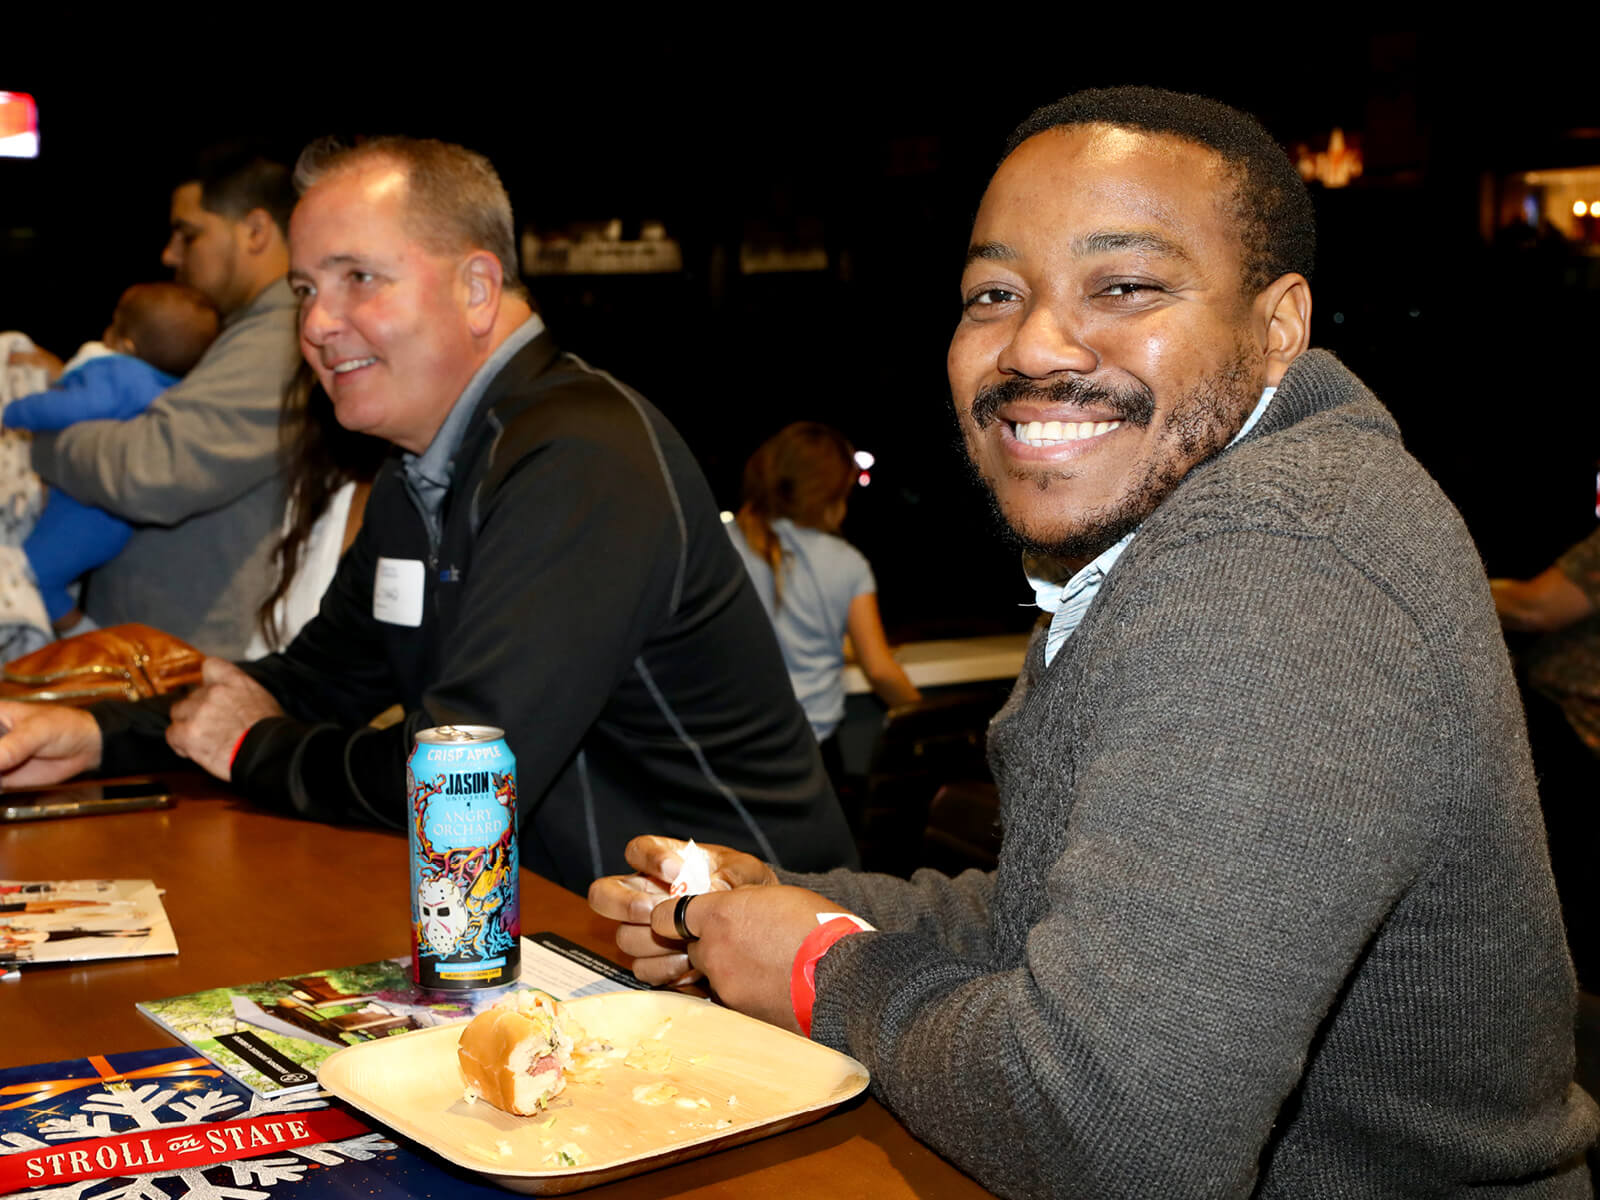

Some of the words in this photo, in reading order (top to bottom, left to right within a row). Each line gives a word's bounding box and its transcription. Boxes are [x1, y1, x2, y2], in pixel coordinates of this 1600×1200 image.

[427, 748, 463, 761] CRISP
[467, 745, 502, 760] APPLE
[446, 771, 489, 795] JASON
[442, 808, 493, 822] ANGRY
[433, 820, 502, 836] ORCHARD
[26, 1139, 164, 1179] STROLL
[167, 1136, 202, 1153] on
[206, 1120, 310, 1155] STATE
